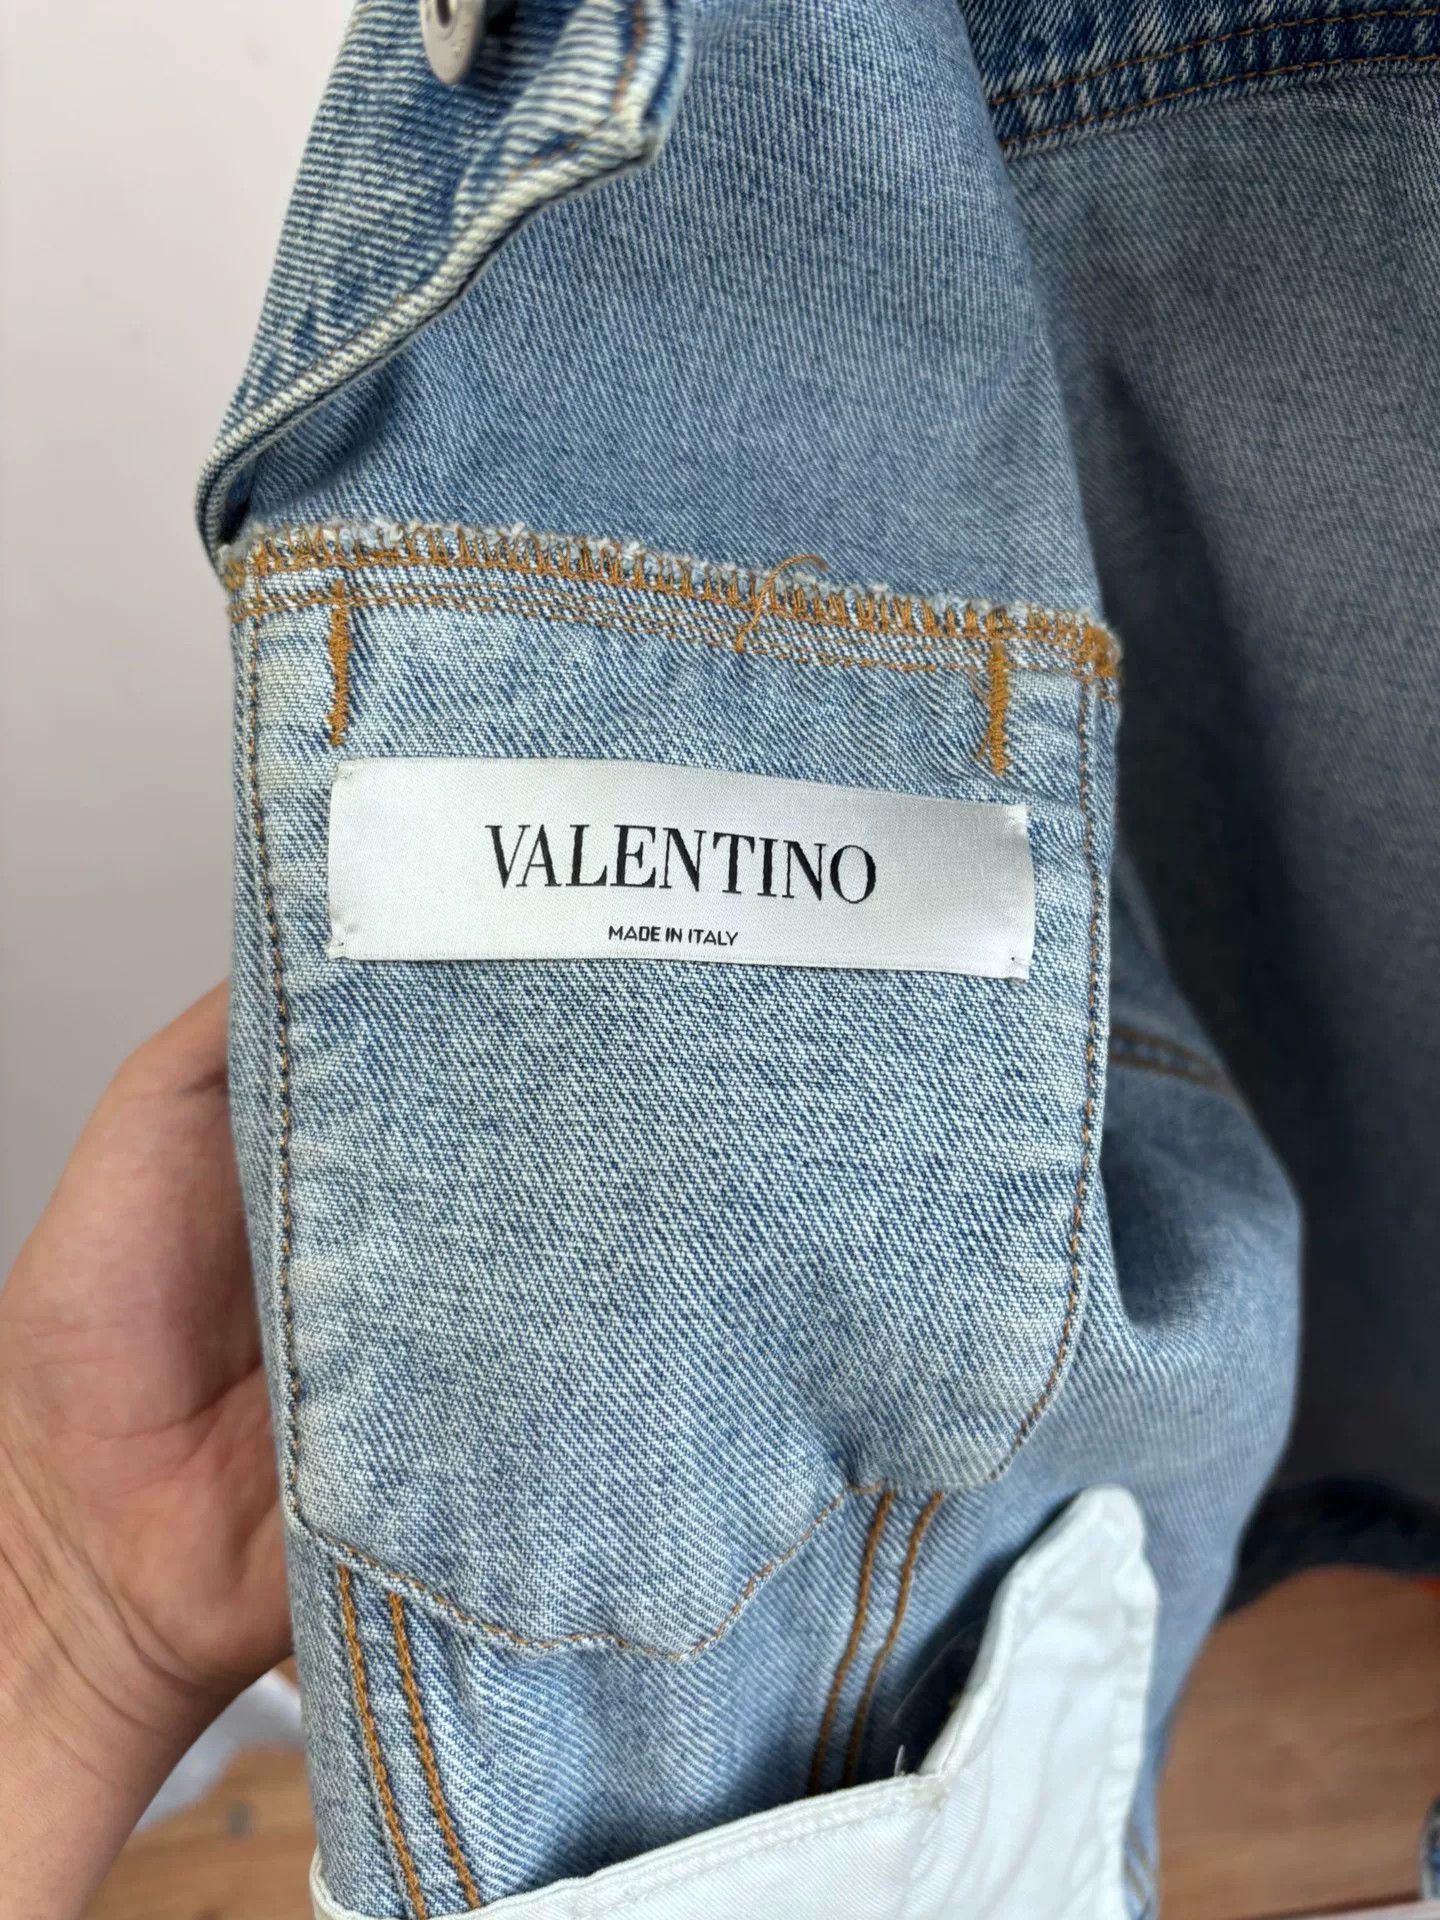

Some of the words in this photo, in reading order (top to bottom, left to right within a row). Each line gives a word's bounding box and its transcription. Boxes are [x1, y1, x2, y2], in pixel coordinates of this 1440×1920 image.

[485, 824, 877, 905] VALENTINO
[608, 925, 661, 942] MADE
[665, 927, 683, 943] IN
[687, 928, 739, 946] ITALY
